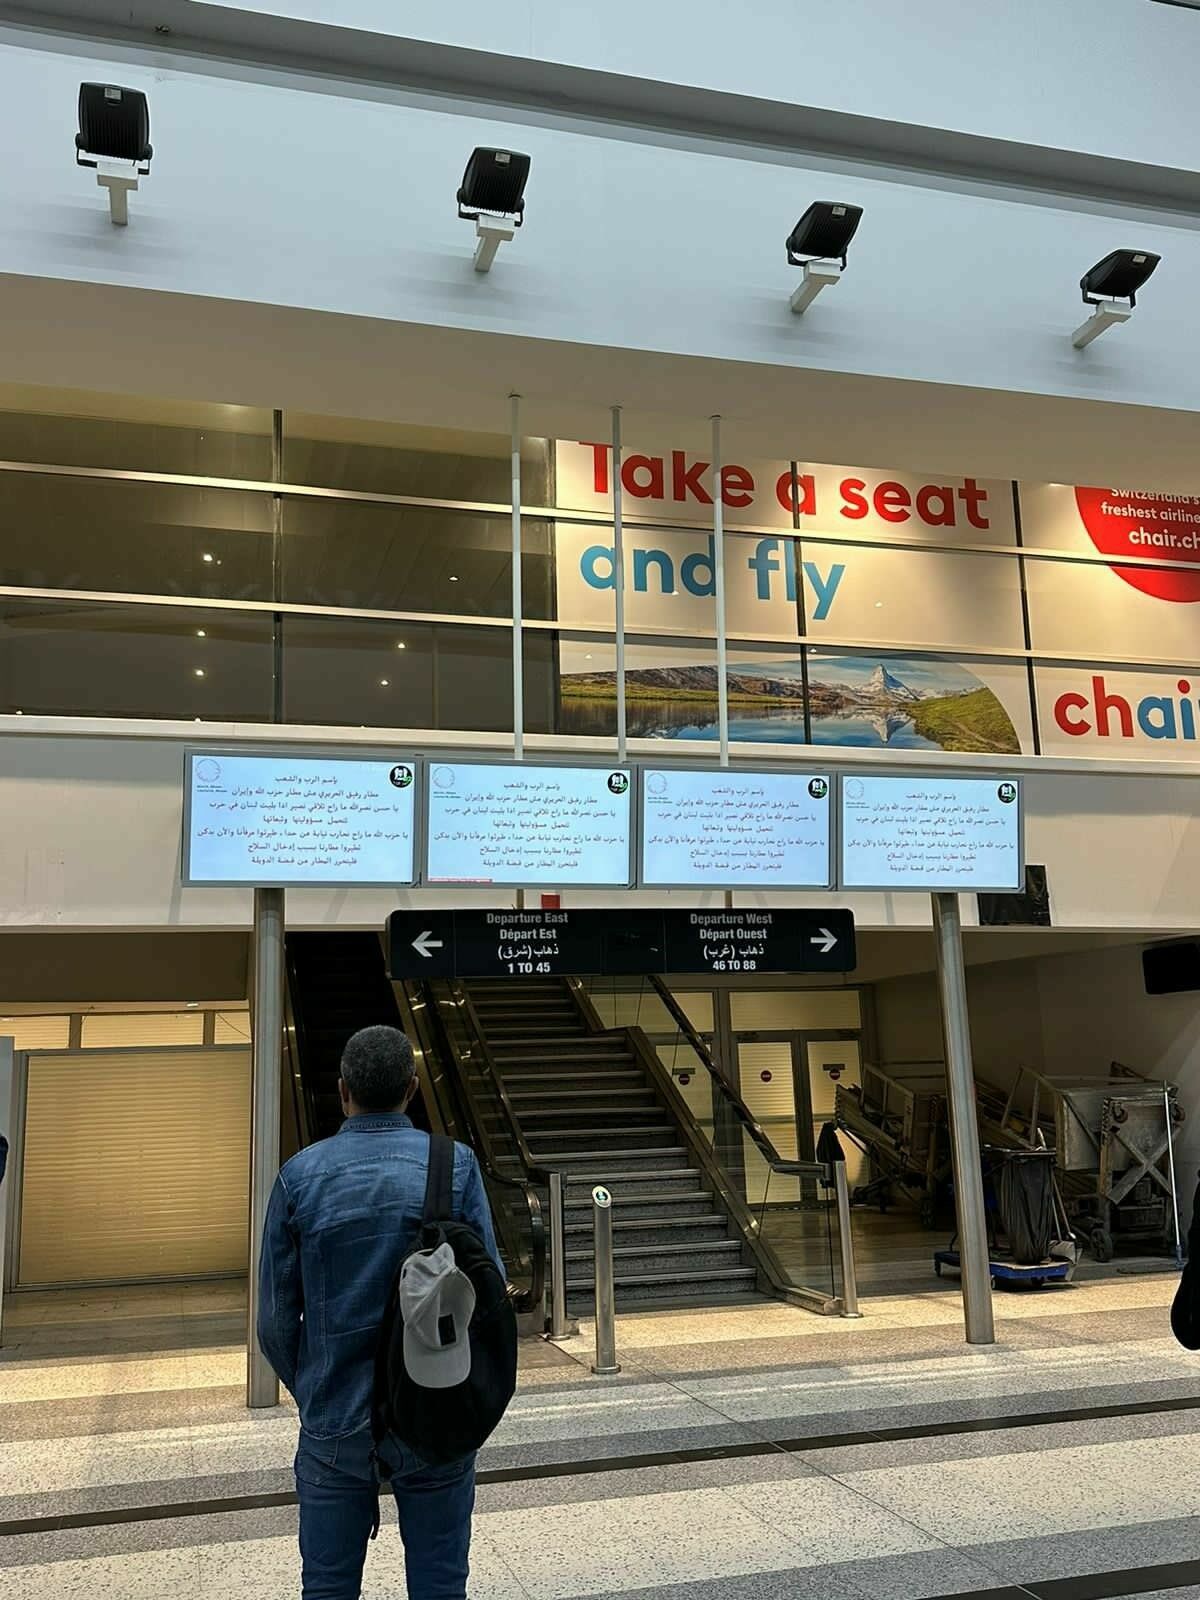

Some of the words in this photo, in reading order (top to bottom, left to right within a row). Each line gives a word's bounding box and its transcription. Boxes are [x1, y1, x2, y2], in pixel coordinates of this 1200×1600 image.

[578, 442, 754, 508] Take
[775, 471, 816, 516] a
[839, 477, 989, 529] seat
[1101, 501, 1158, 519] freshest
[1160, 508, 1200, 523] airline
[579, 534, 715, 597] and
[748, 538, 846, 620] fly
[1054, 676, 1200, 740] chai
[486, 913, 542, 925] Departure
[545, 912, 568, 923] East
[690, 913, 743, 926] Departure
[746, 913, 772, 924] West
[499, 928, 537, 941] Départ
[539, 928, 557, 939] Est
[699, 928, 734, 941] Départ
[736, 928, 767, 939] Ouest
[533, 944, 559, 957] ذهاب
[704, 944, 735, 960] (غرب)
[739, 944, 764, 957] ذهاب
[507, 963, 514, 973] 1
[518, 962, 532, 973] TO
[536, 962, 551, 973] 45
[713, 960, 725, 970] 46
[727, 960, 740, 970] TO
[743, 960, 756, 970] 88
